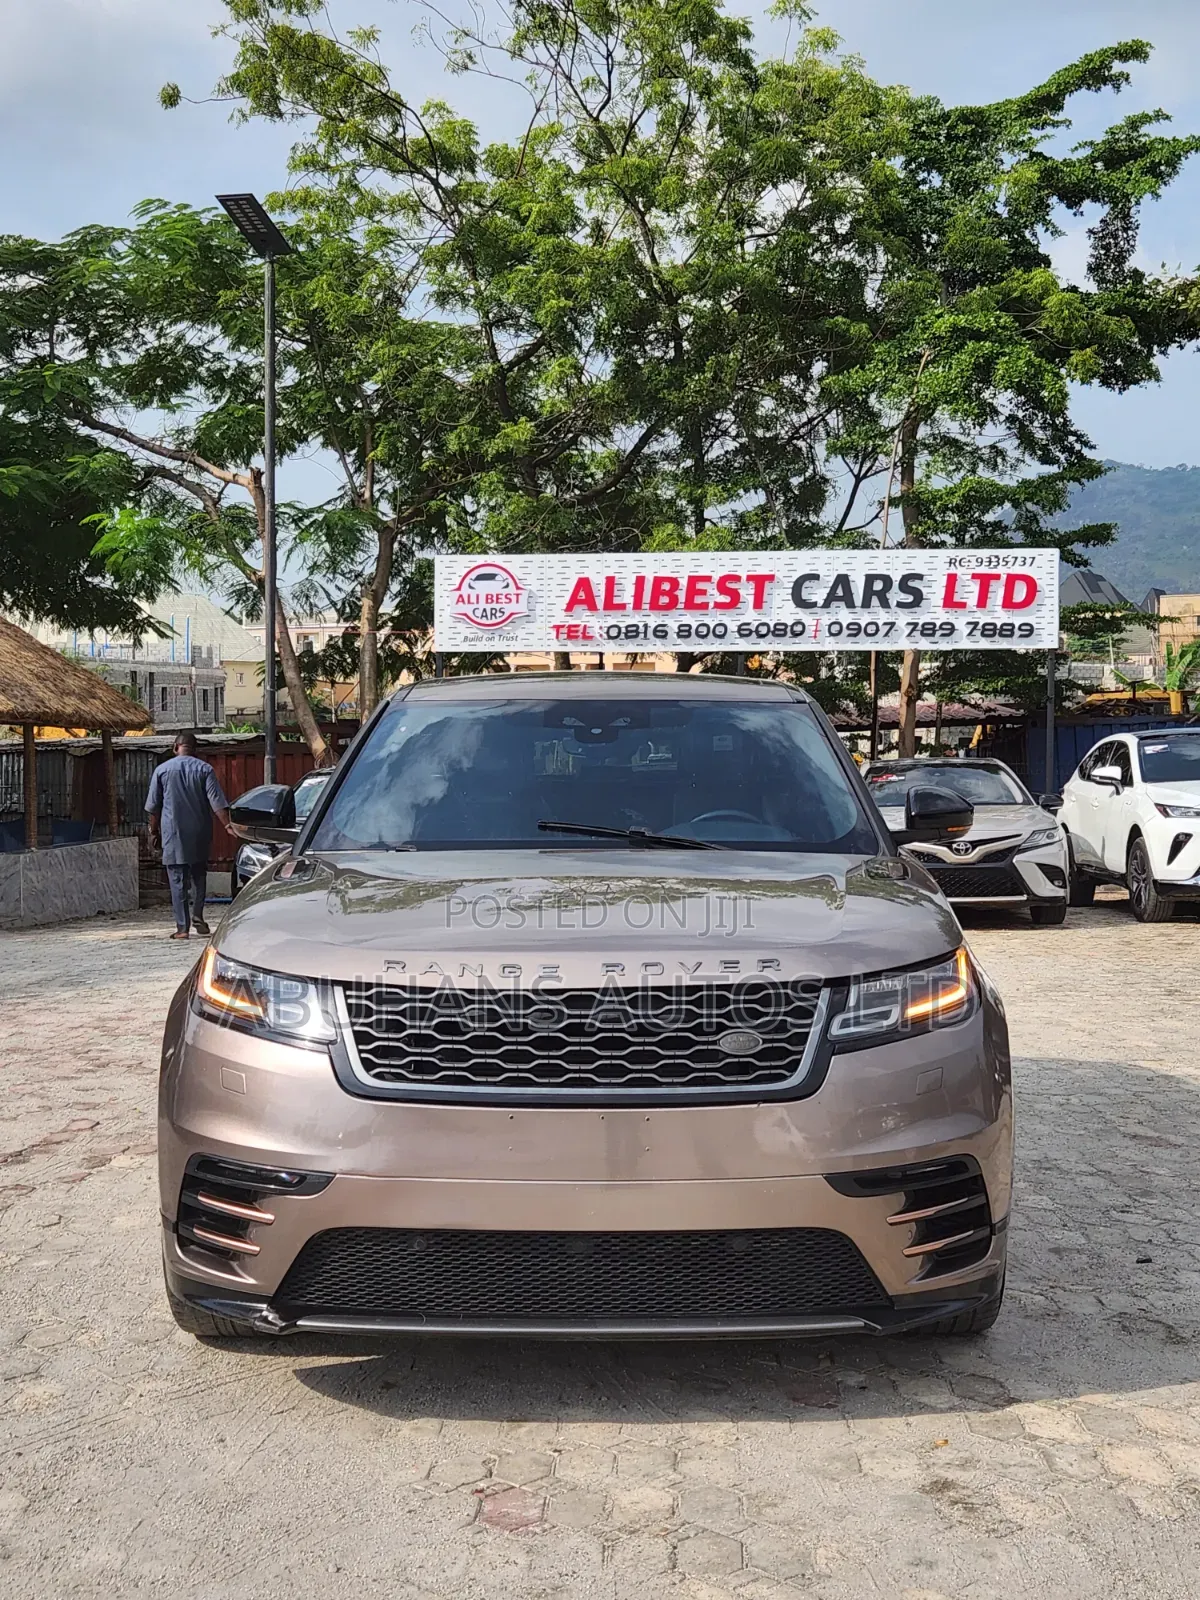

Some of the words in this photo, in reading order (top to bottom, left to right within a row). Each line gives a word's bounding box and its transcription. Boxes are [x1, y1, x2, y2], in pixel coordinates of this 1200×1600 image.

[974, 556, 1037, 568] 9335737
[455, 593, 480, 605] ALI
[485, 592, 523, 605] BEST
[564, 574, 775, 612] ALIBEST
[791, 572, 925, 609] CARS
[942, 572, 1038, 611] LTD
[472, 607, 506, 621] CARS
[606, 623, 669, 640] 0816
[676, 622, 728, 640] 800
[737, 621, 805, 639] 6080
[828, 621, 896, 639] 0907
[905, 621, 956, 639] 789
[965, 621, 1035, 639] 7889
[463, 634, 484, 643] Build
[485, 635, 495, 643] on
[498, 634, 519, 643] Trust
[382, 960, 560, 980] RANGE
[600, 958, 781, 977] ROVER
